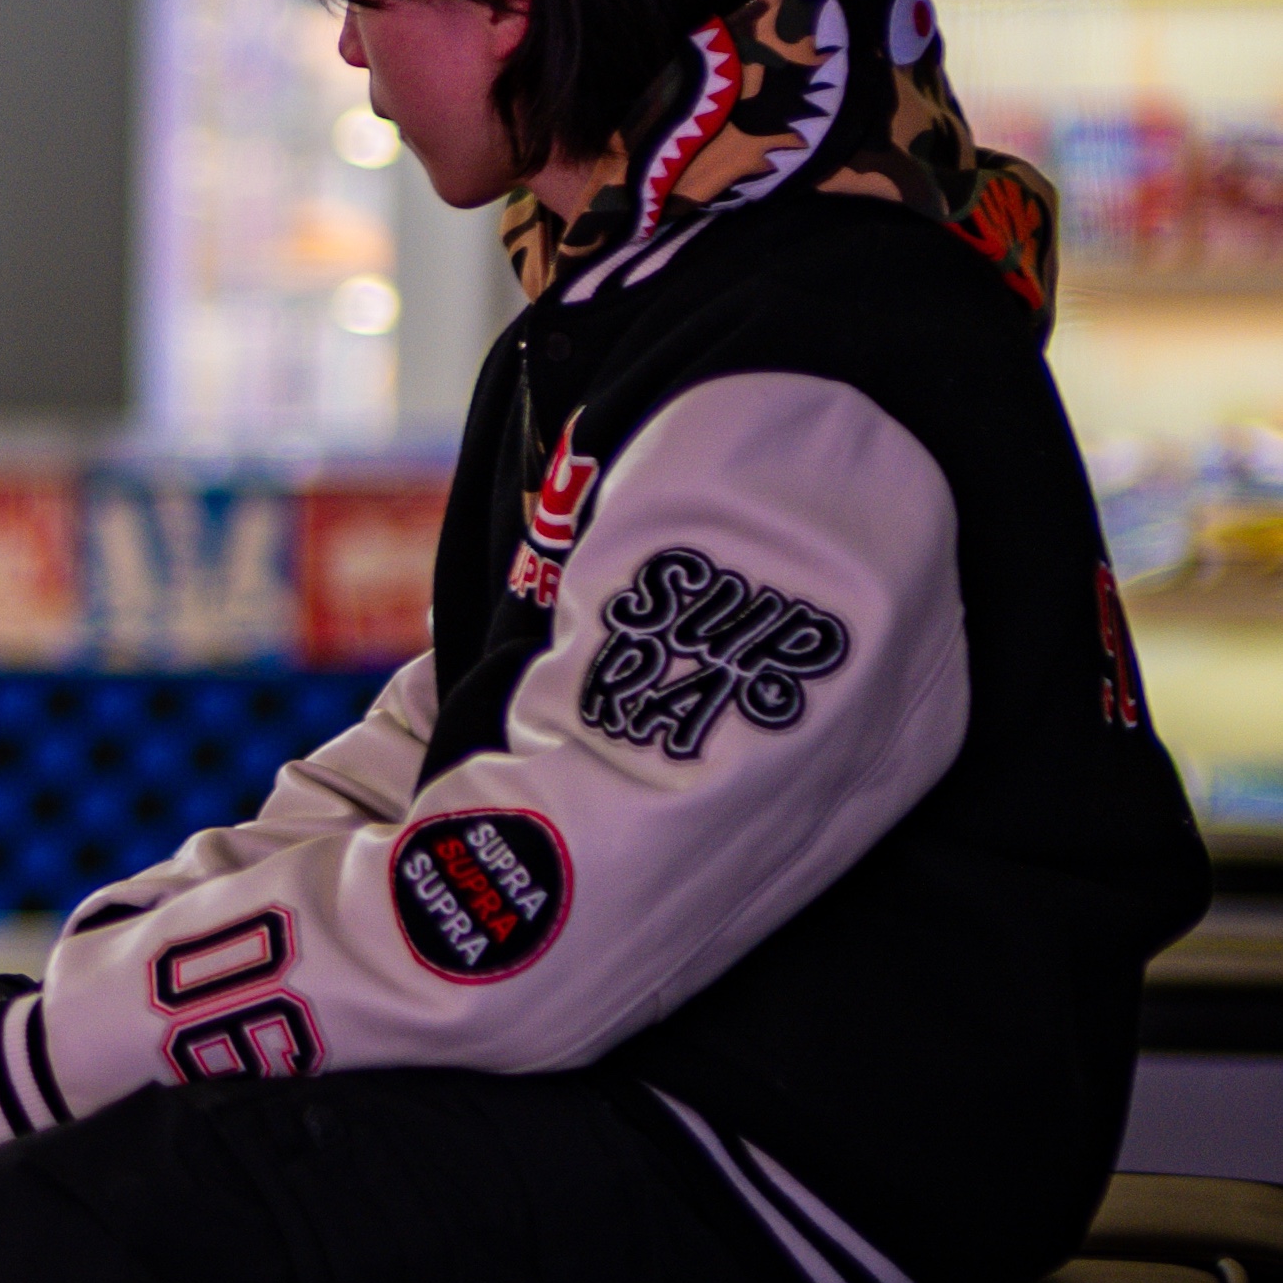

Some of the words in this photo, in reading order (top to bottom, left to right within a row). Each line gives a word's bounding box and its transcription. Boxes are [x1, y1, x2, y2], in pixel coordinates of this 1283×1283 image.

[402, 852, 489, 966] SUPRA
[436, 838, 519, 944] SUPRA
[466, 822, 549, 920] SUPRA
